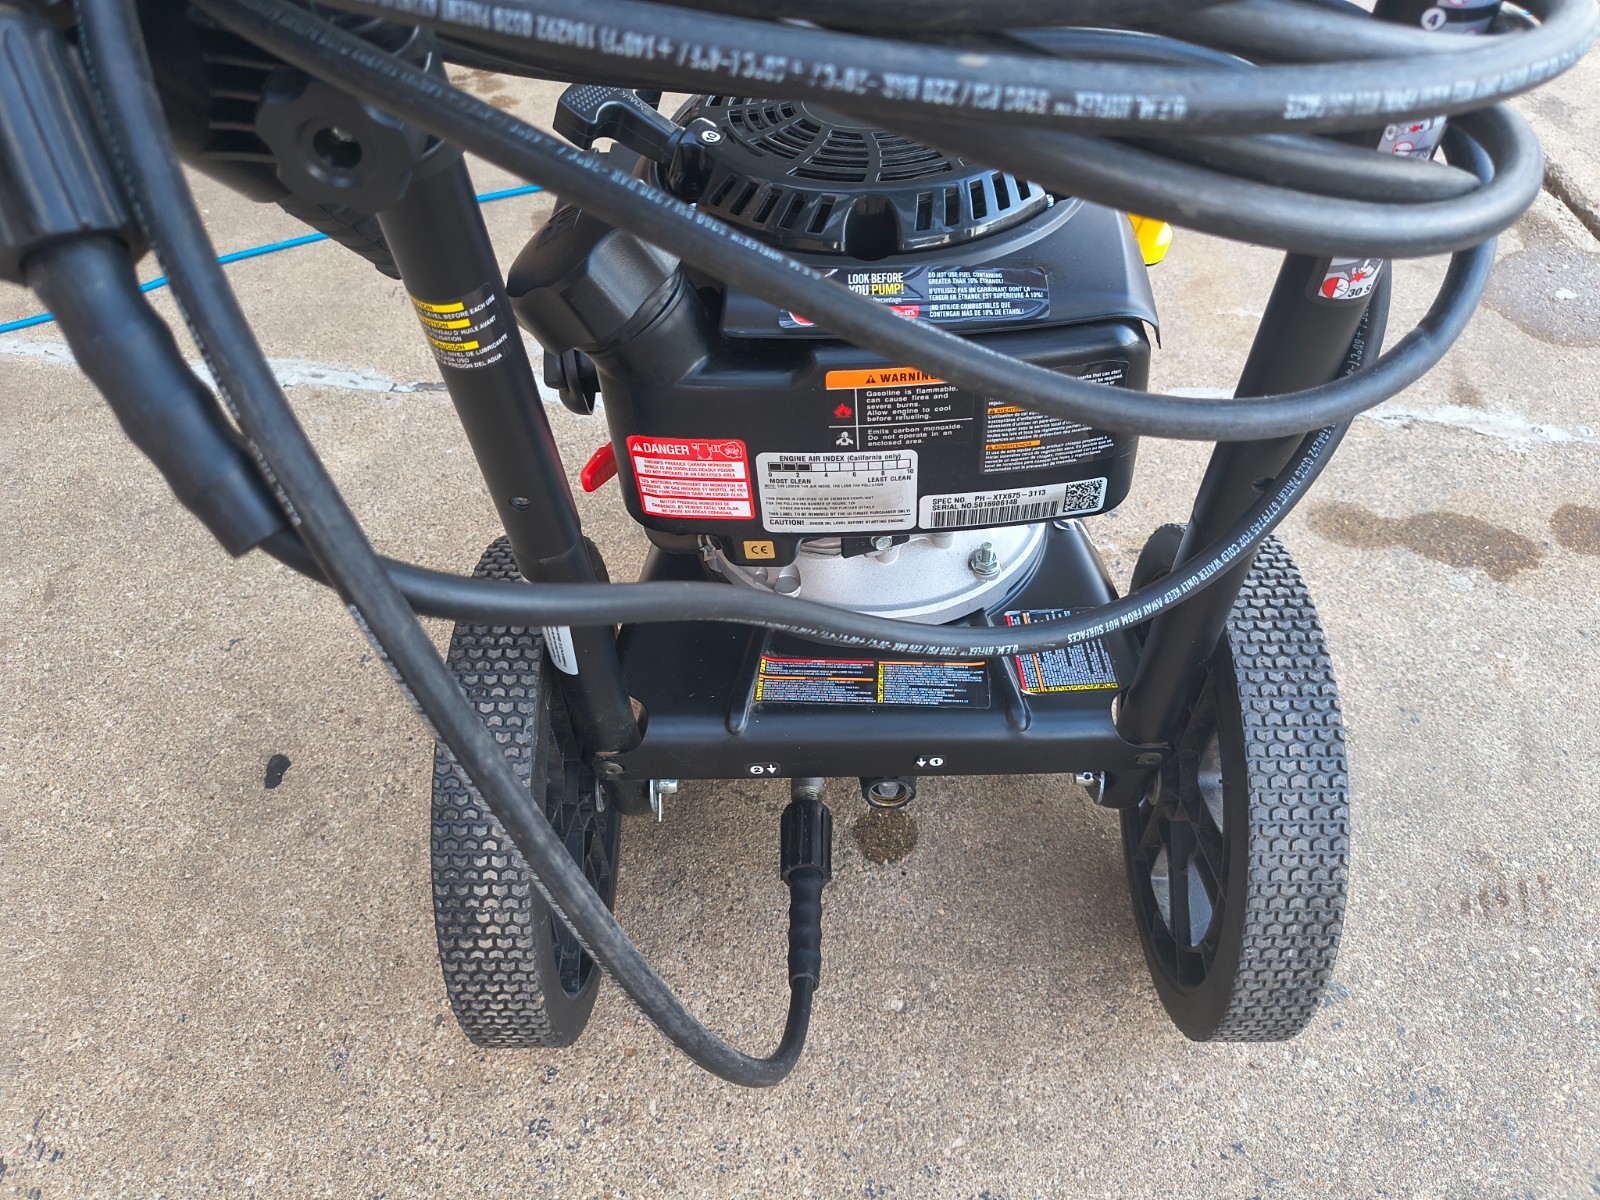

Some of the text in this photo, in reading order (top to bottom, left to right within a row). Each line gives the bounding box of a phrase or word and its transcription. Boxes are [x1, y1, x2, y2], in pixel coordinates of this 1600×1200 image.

[848, 272, 904, 284] LOOK BEFORE
[848, 283, 904, 295] YOU PUMP!
[1348, 287, 1362, 297] 30
[443, 310, 469, 320] BEFORE
[469, 303, 486, 314] EACH
[486, 294, 496, 306] USE
[461, 325, 479, 335] HUILE
[480, 315, 496, 329] AVANT
[476, 333, 508, 355] LUBRICANTE
[487, 353, 502, 364] AGUA
[916, 386, 958, 394] flammable.
[892, 408, 919, 416] engine
[643, 443, 690, 455] DANGER
[1276, 476, 1301, 505] PATENT
[1239, 530, 1254, 547] FOR
[751, 546, 768, 554] CE
[1221, 543, 1240, 563] COLD
[1198, 558, 1224, 582] WATER
[1181, 576, 1200, 593] ONLY
[1165, 587, 1182, 604] KEEP
[1143, 598, 1163, 615] AWAY
[1121, 608, 1142, 626] FROM
[1068, 624, 1104, 644] SURFACES
[1105, 619, 1120, 633] HOT
